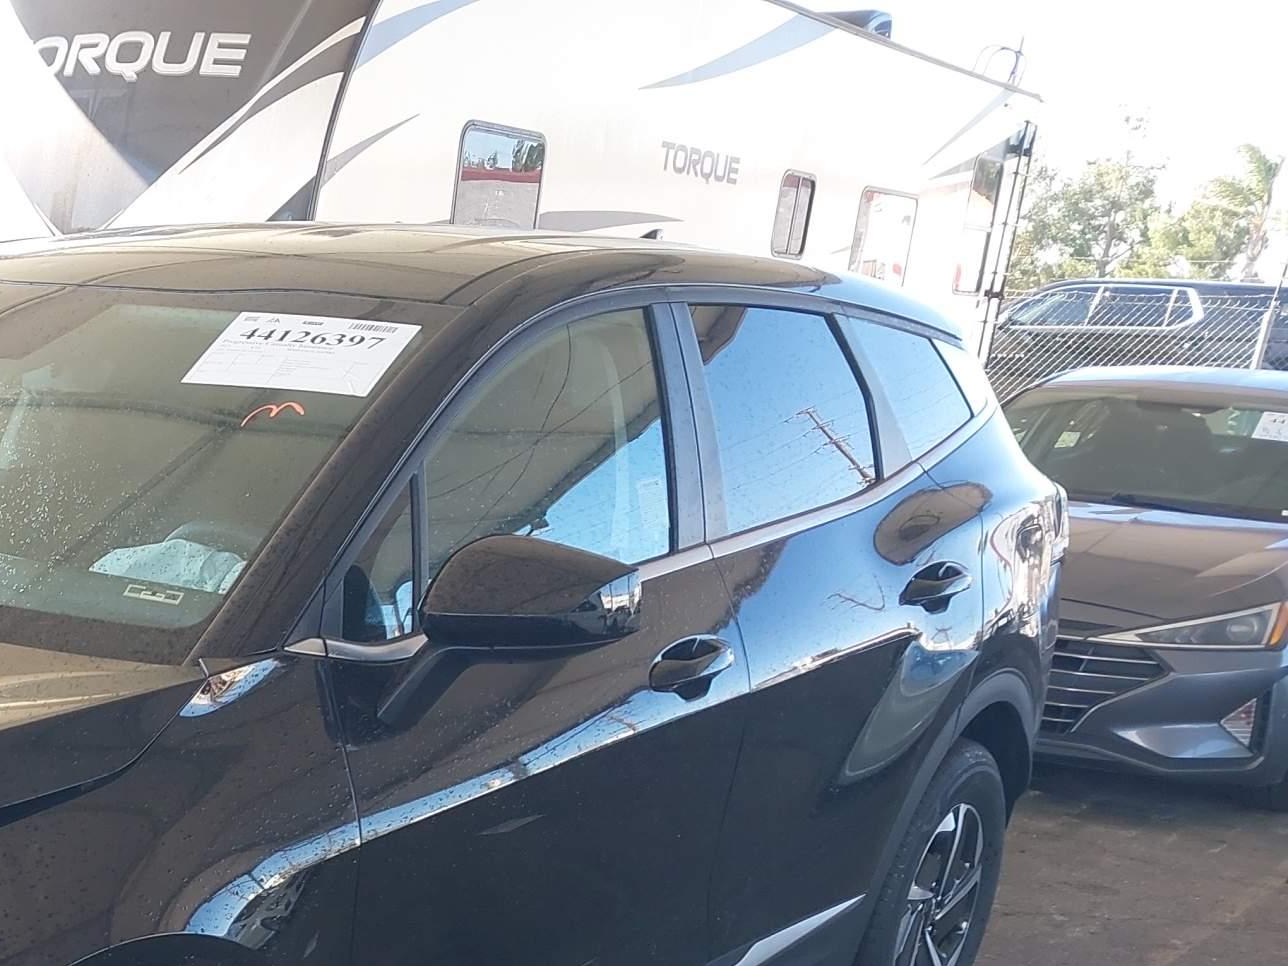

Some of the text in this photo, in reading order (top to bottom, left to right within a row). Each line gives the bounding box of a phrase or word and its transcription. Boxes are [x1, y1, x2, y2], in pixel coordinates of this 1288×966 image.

[33, 30, 253, 83] ORQUE
[661, 140, 741, 185] TORQUE
[239, 327, 387, 350] 44126397
